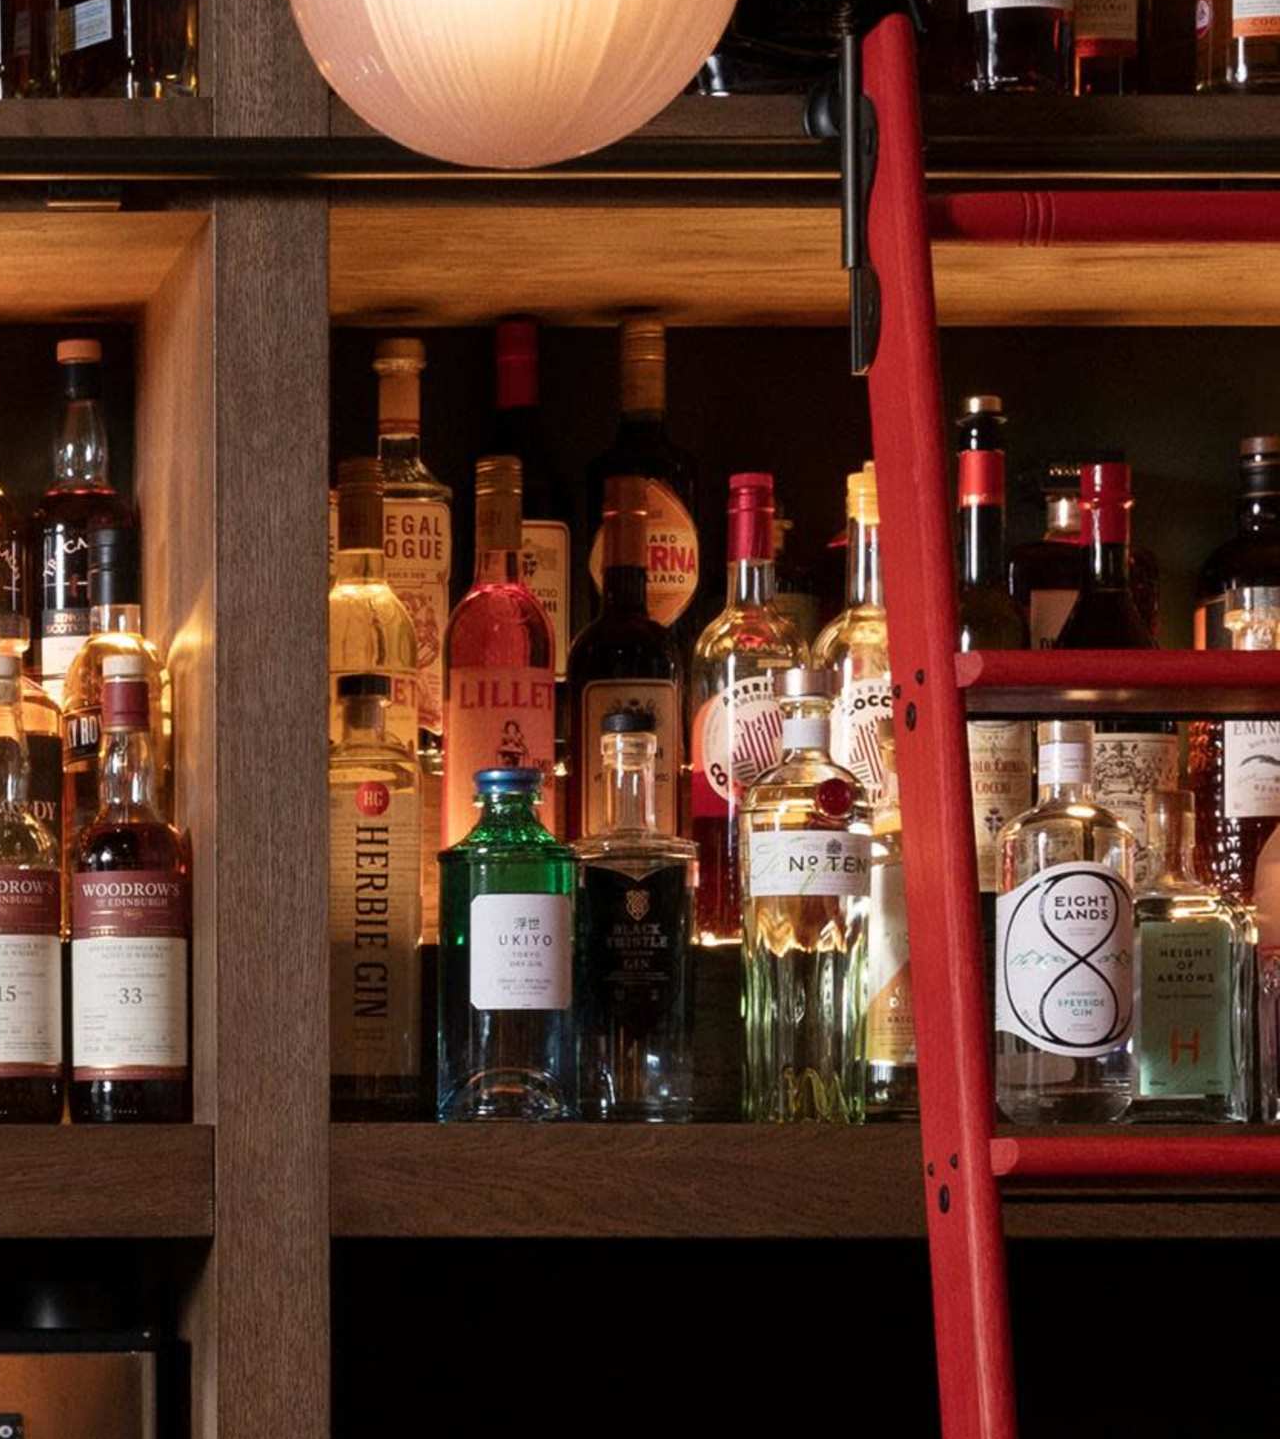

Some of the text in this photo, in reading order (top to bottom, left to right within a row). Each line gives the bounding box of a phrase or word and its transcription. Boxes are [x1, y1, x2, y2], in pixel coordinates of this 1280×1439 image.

[826, 856, 867, 874] TEN
[81, 882, 181, 898] WOODROW'S
[1054, 895, 1109, 908] EIGHT
[1054, 909, 1109, 921] LANDS
[353, 825, 390, 1019] HERBIE GIN
[498, 934, 553, 947] UKIYO
[1159, 948, 1213, 959] HEIGHT
[1157, 973, 1215, 984] ARROWS
[118, 987, 143, 1005] 33
